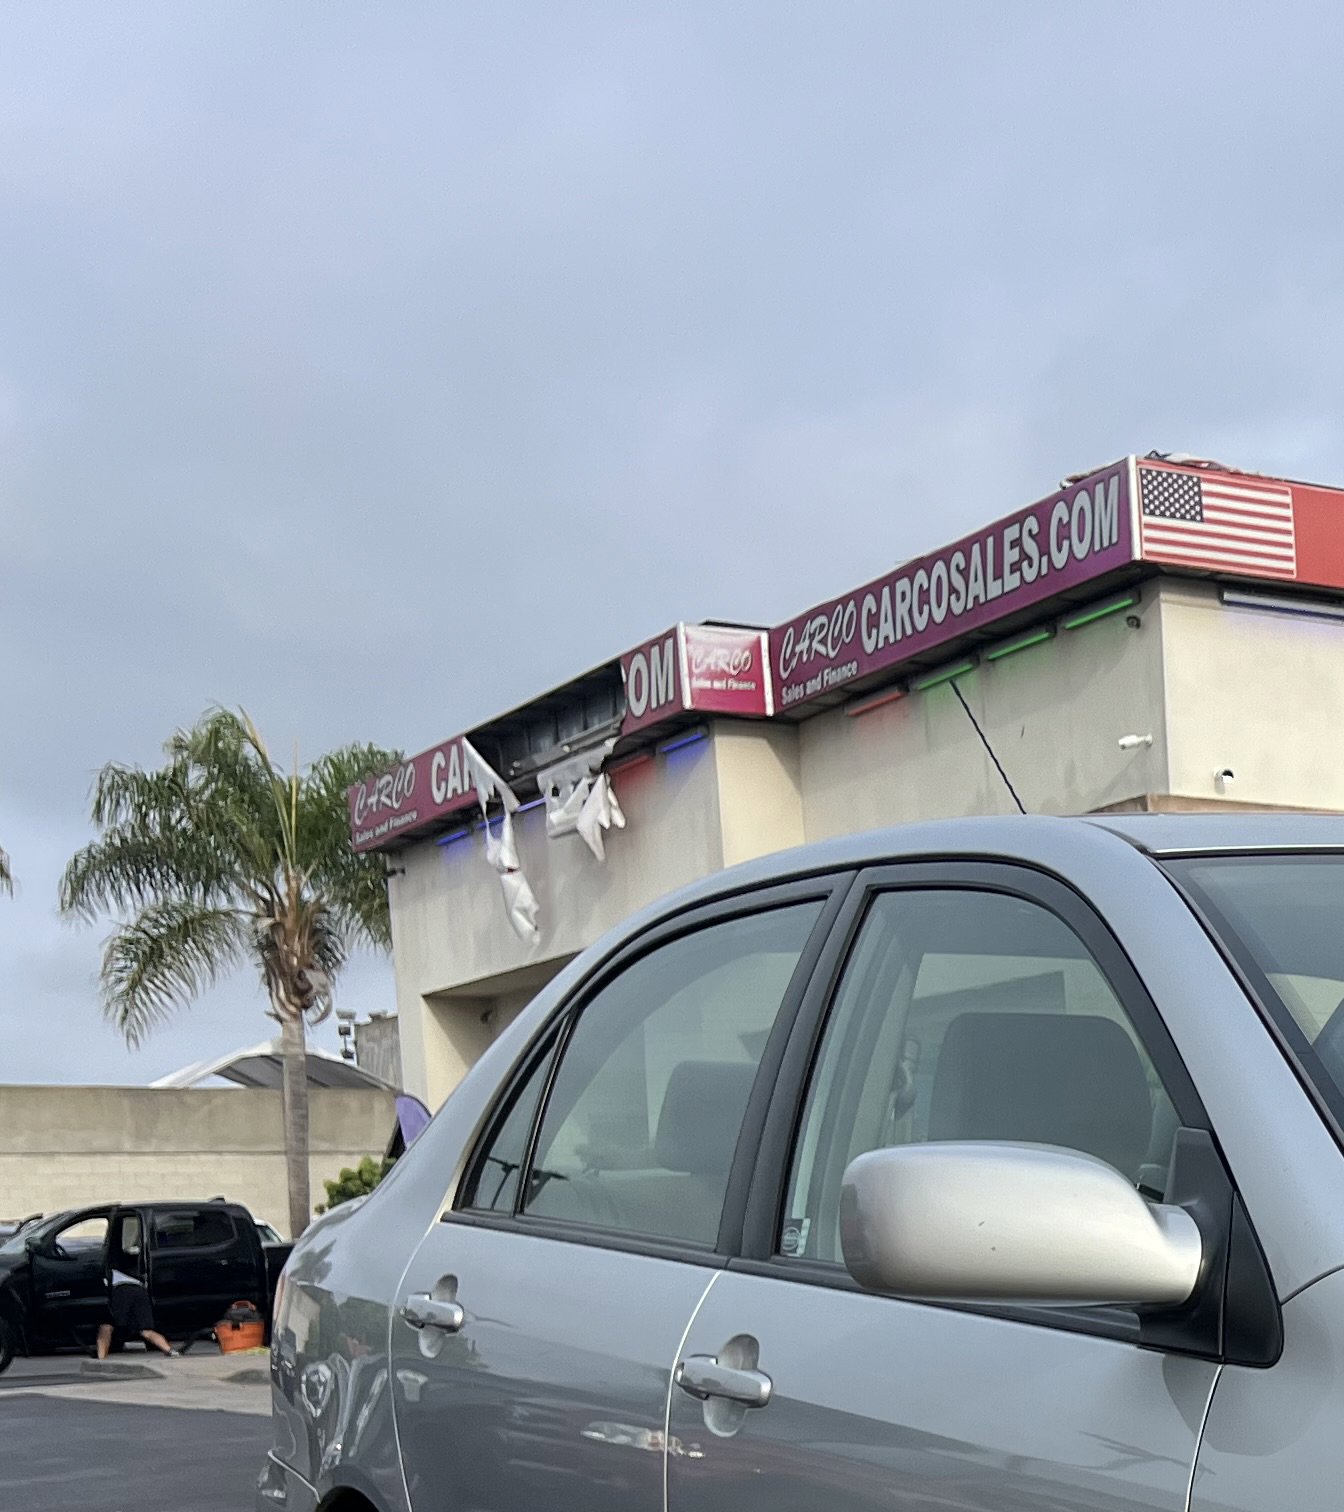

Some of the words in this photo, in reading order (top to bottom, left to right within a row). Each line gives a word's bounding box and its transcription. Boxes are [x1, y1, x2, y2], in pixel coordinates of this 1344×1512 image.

[780, 599, 857, 681] CARCO
[860, 474, 1120, 655] CARCOSALES.COM
[621, 637, 675, 718] OM
[691, 647, 752, 676] CARCO
[727, 679, 756, 691] Finance
[782, 685, 804, 705] Sales
[805, 673, 822, 696] and
[823, 660, 858, 689] Finance
[355, 762, 416, 826] CARCO
